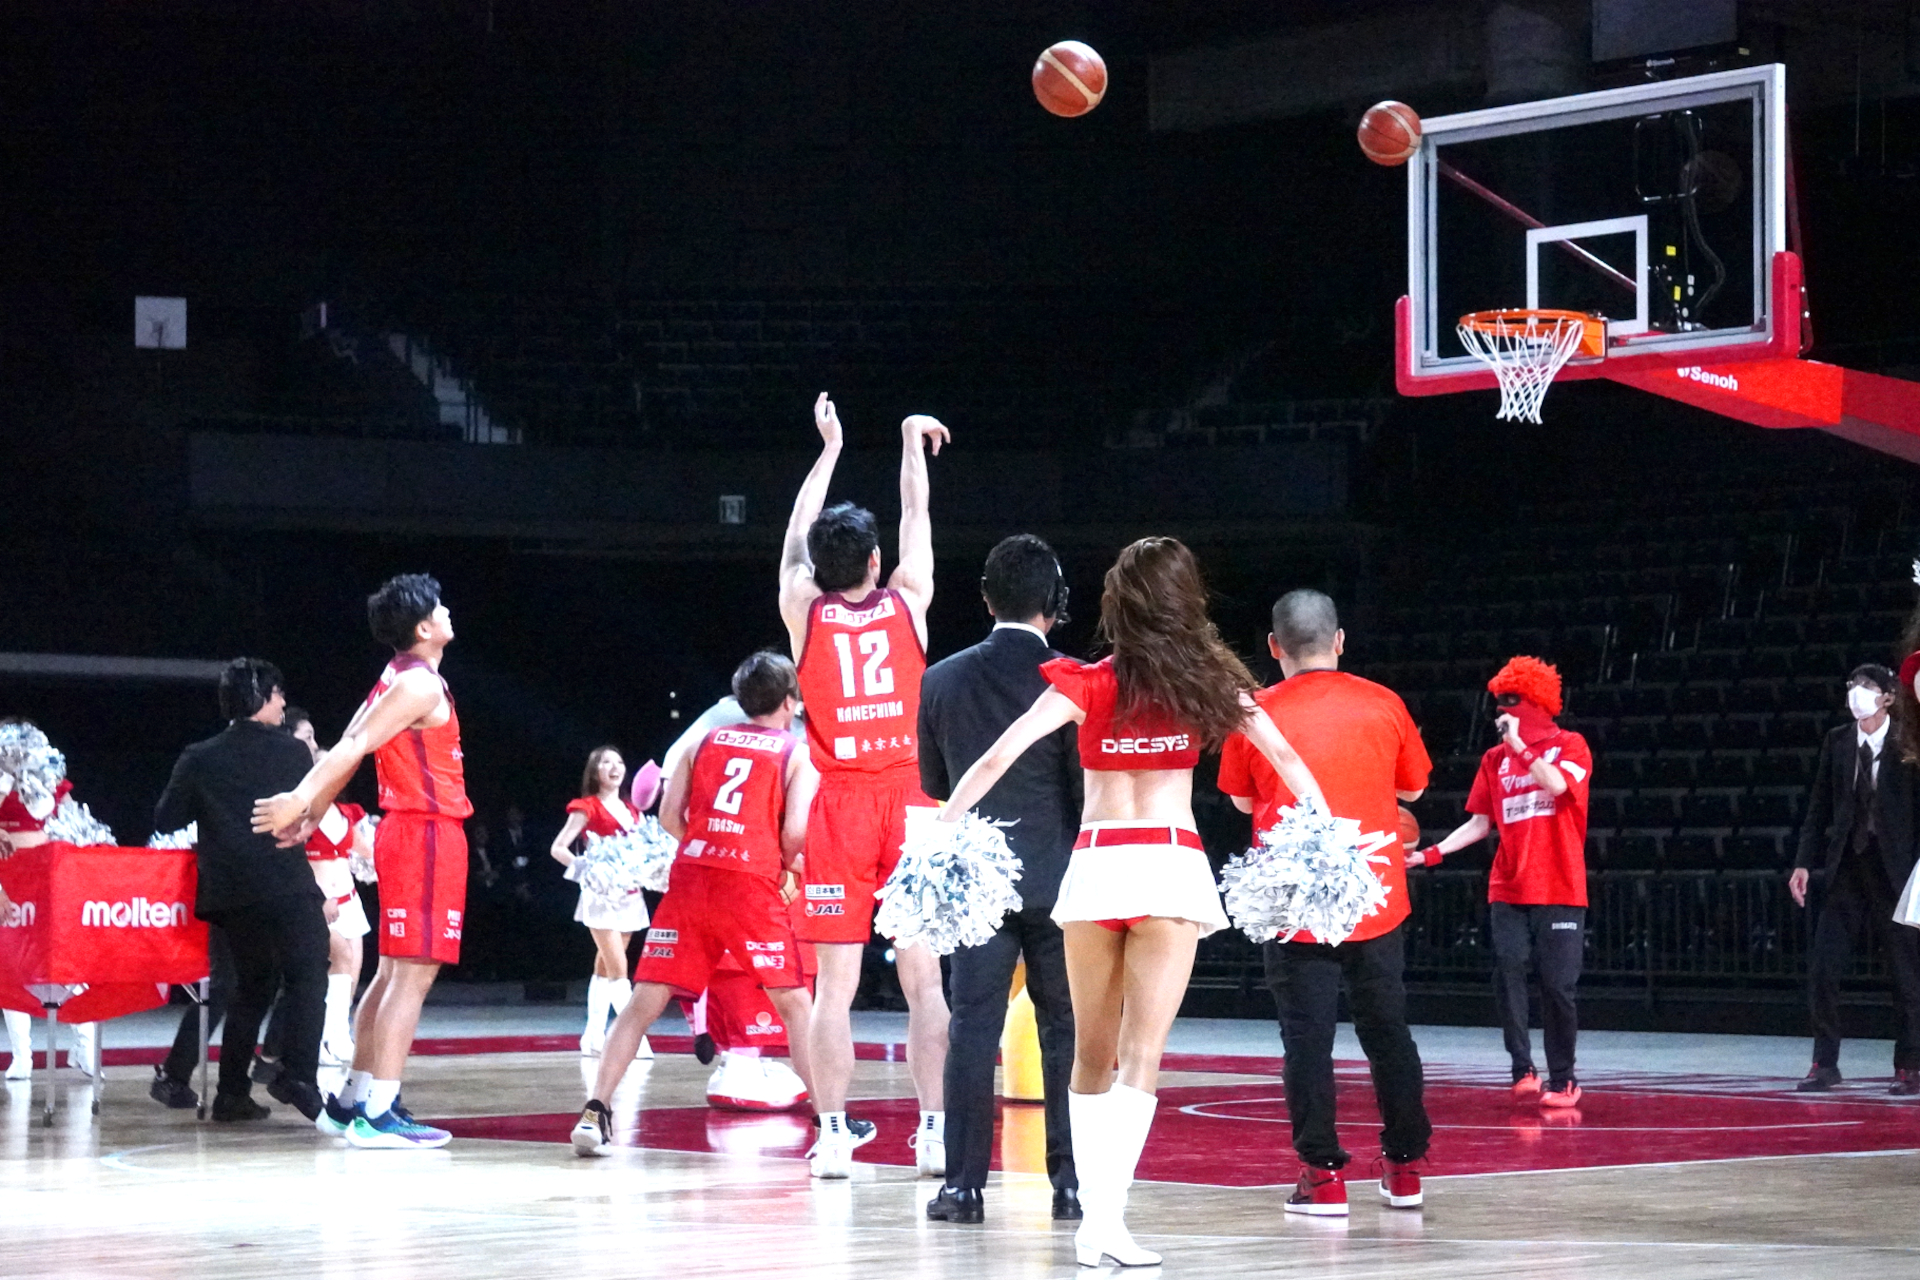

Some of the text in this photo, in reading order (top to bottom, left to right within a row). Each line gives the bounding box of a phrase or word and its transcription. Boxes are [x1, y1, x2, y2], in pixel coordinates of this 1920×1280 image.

[1690, 366, 1739, 391] Senoh
[833, 630, 895, 698] 12
[1101, 733, 1190, 754] DECSYS
[713, 757, 754, 815] 2
[81, 897, 188, 928] molten
[814, 904, 845, 915] JAL
